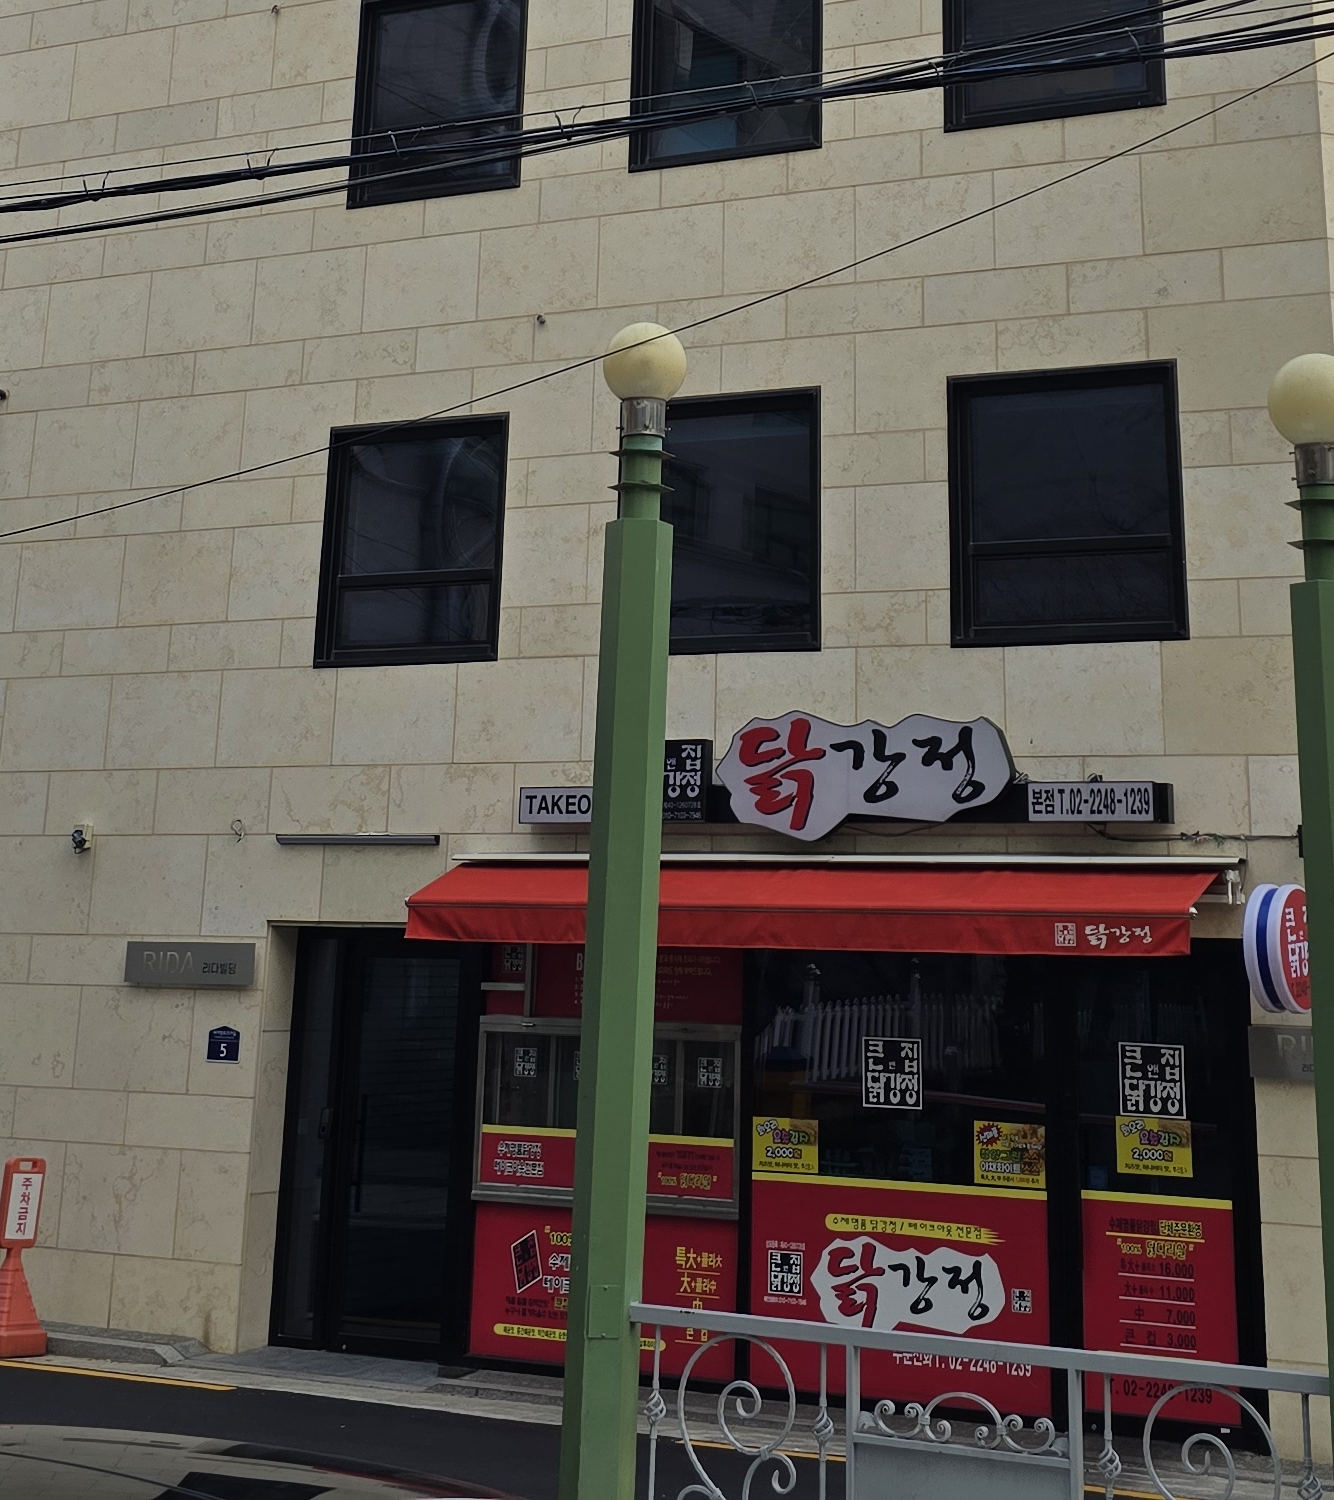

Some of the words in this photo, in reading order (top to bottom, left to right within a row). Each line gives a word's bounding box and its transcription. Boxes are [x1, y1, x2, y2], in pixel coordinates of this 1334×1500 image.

[738, 717, 986, 831] 닭강정
[1030, 787, 1056, 815] 본점
[1084, 923, 1153, 950] 닭강정
[142, 951, 194, 975] RIDA
[202, 962, 237, 975] 리다빌딩
[219, 1042, 228, 1058] 5
[866, 1071, 918, 1105] 닭강정
[1123, 1078, 1181, 1115] 닭강정
[15, 1176, 34, 1237] 주차금지
[869, 1218, 898, 1234] 닭강정
[827, 1241, 991, 1329] 닭강정
